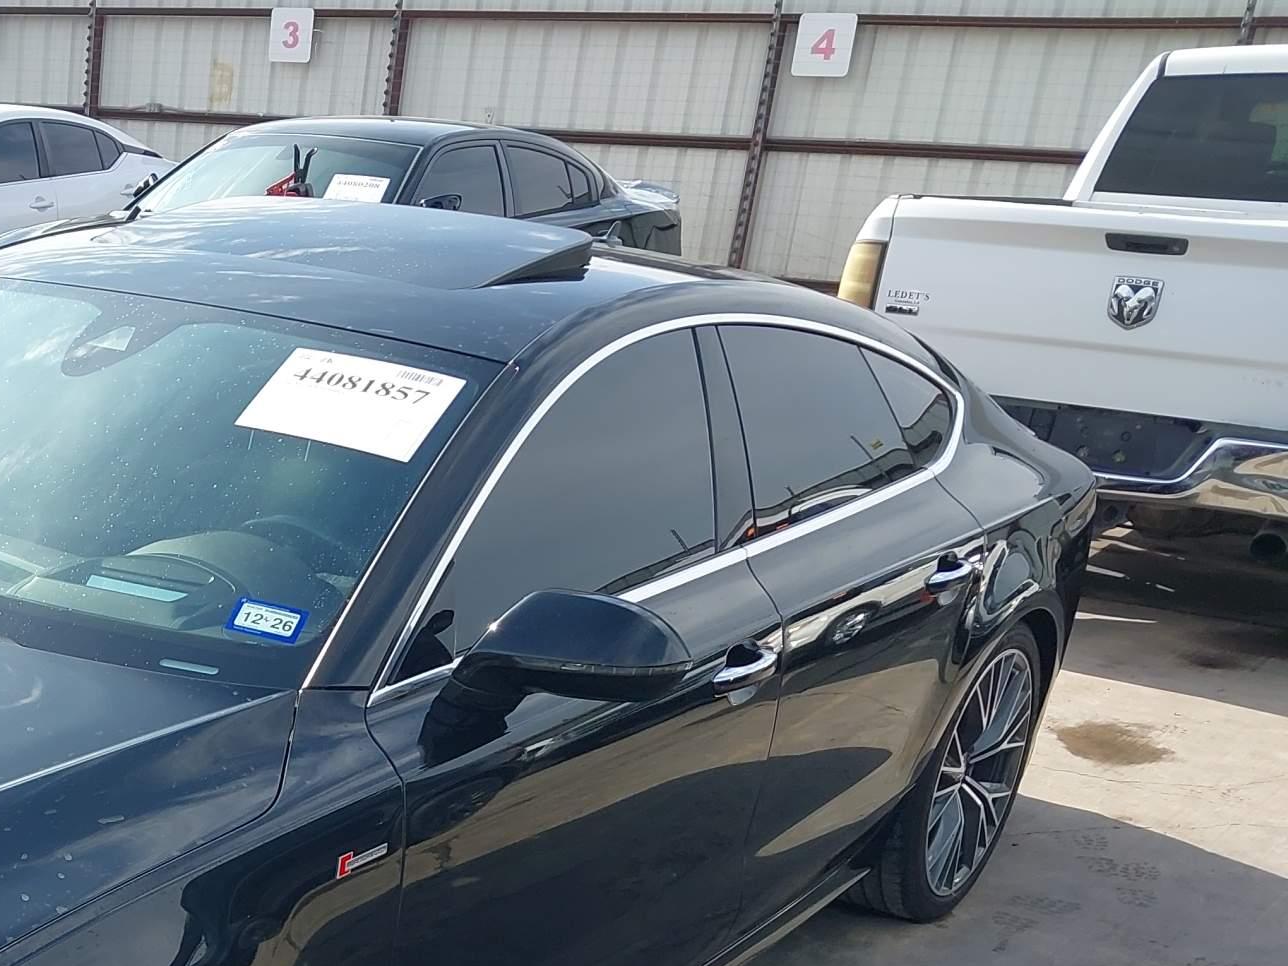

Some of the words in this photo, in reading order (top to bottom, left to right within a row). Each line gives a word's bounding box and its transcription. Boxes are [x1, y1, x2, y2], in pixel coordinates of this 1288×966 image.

[282, 21, 300, 49] 3
[810, 28, 836, 61] 4
[1117, 277, 1160, 287] DODGE
[294, 367, 431, 405] 44081857
[242, 611, 264, 625] 12
[270, 617, 294, 632] 26
